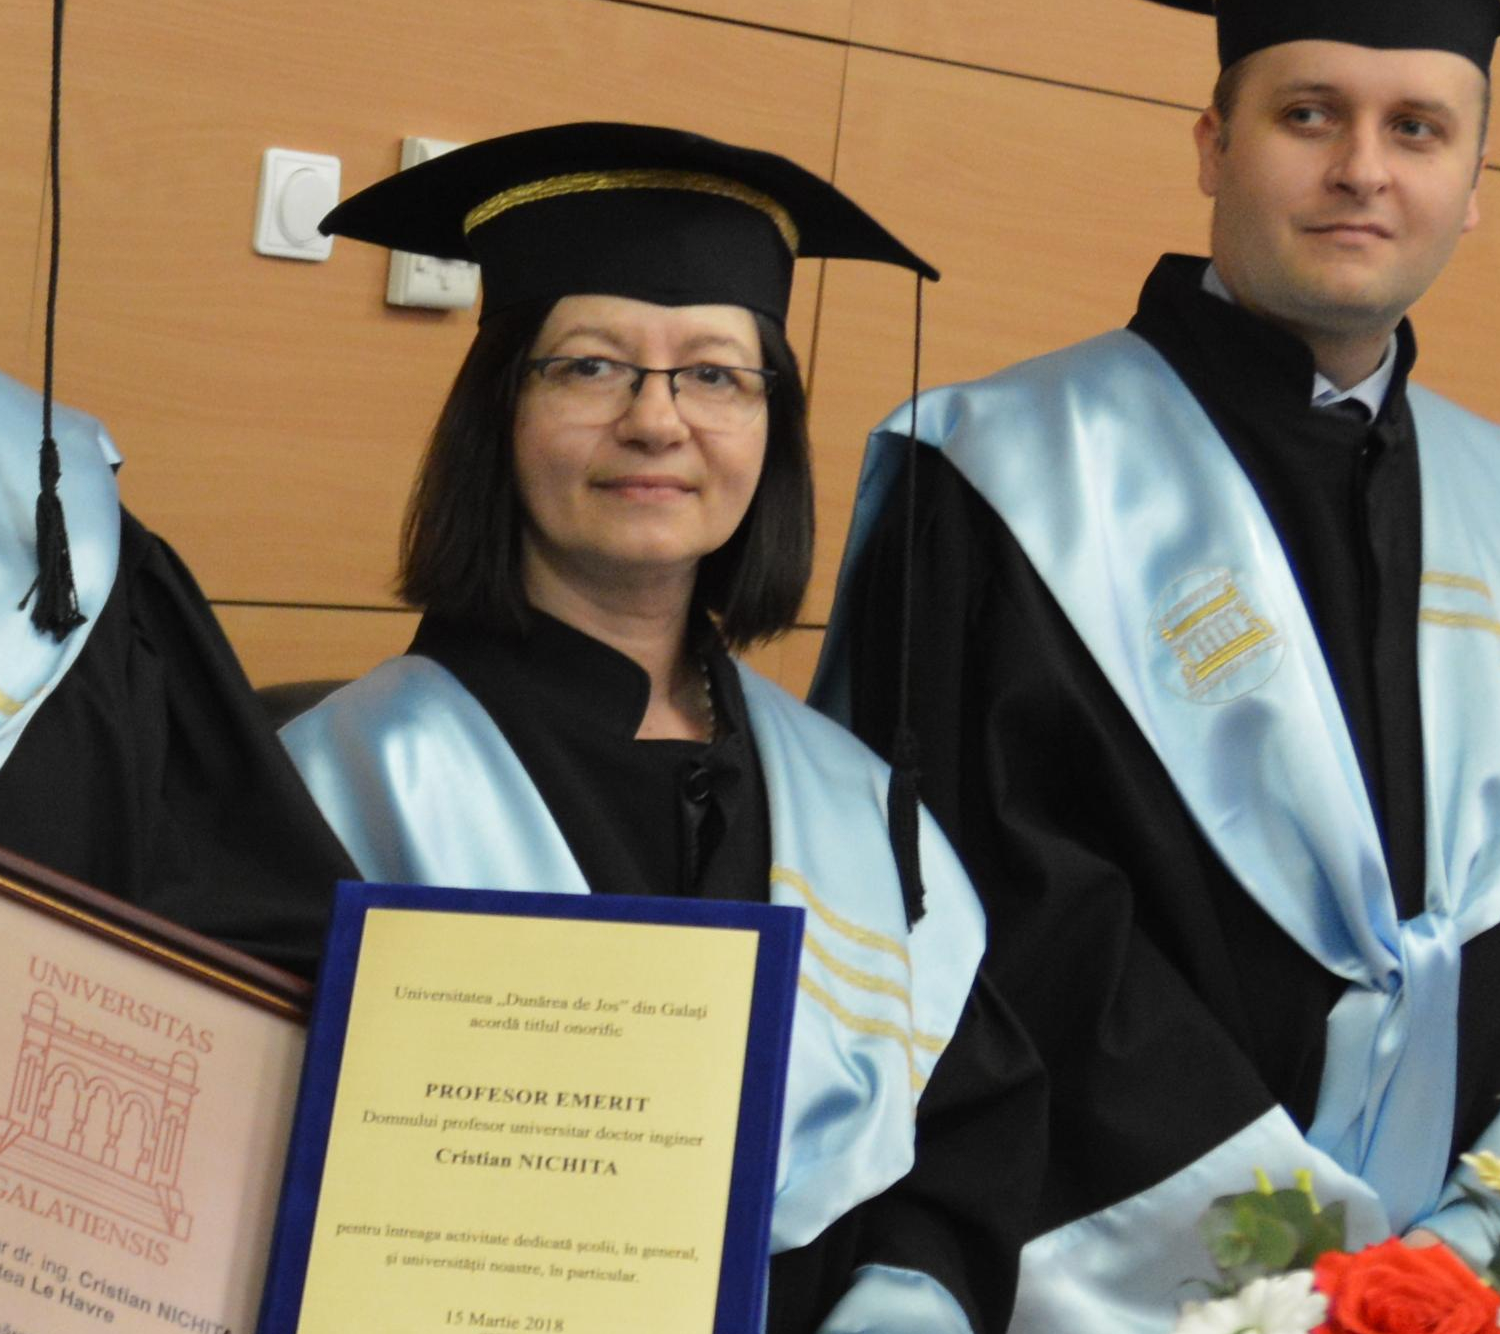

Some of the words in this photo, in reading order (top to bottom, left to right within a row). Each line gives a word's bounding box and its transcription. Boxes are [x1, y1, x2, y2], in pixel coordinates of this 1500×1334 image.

[28, 955, 215, 1054] UNIVERSITAS
[394, 985, 493, 1005] Universitatea
[572, 996, 592, 1012] de
[631, 1000, 657, 1016] din
[469, 1015, 521, 1031] acordă
[523, 1018, 560, 1034] titlul
[563, 1021, 624, 1038] onorific
[424, 1082, 550, 1106] PROFESOR
[555, 1091, 651, 1113] EMERIT
[362, 1109, 439, 1129] Domnului
[441, 1116, 507, 1134] profesor
[509, 1121, 592, 1139] universitar
[594, 1125, 645, 1142] doctor
[649, 1128, 705, 1148] inginer
[435, 1147, 512, 1169] Cristian
[518, 1153, 620, 1177] NICHITA
[336, 1221, 382, 1239] pentru
[445, 1229, 510, 1247] activitate
[14, 1244, 36, 1268] dr.
[41, 1254, 71, 1283] ing.
[79, 1270, 152, 1314] Cristian
[30, 1276, 55, 1300] Le
[59, 1287, 115, 1324] Havre
[445, 1309, 464, 1326] 15
[467, 1311, 520, 1330] Martie
[524, 1315, 566, 1333] 2018
